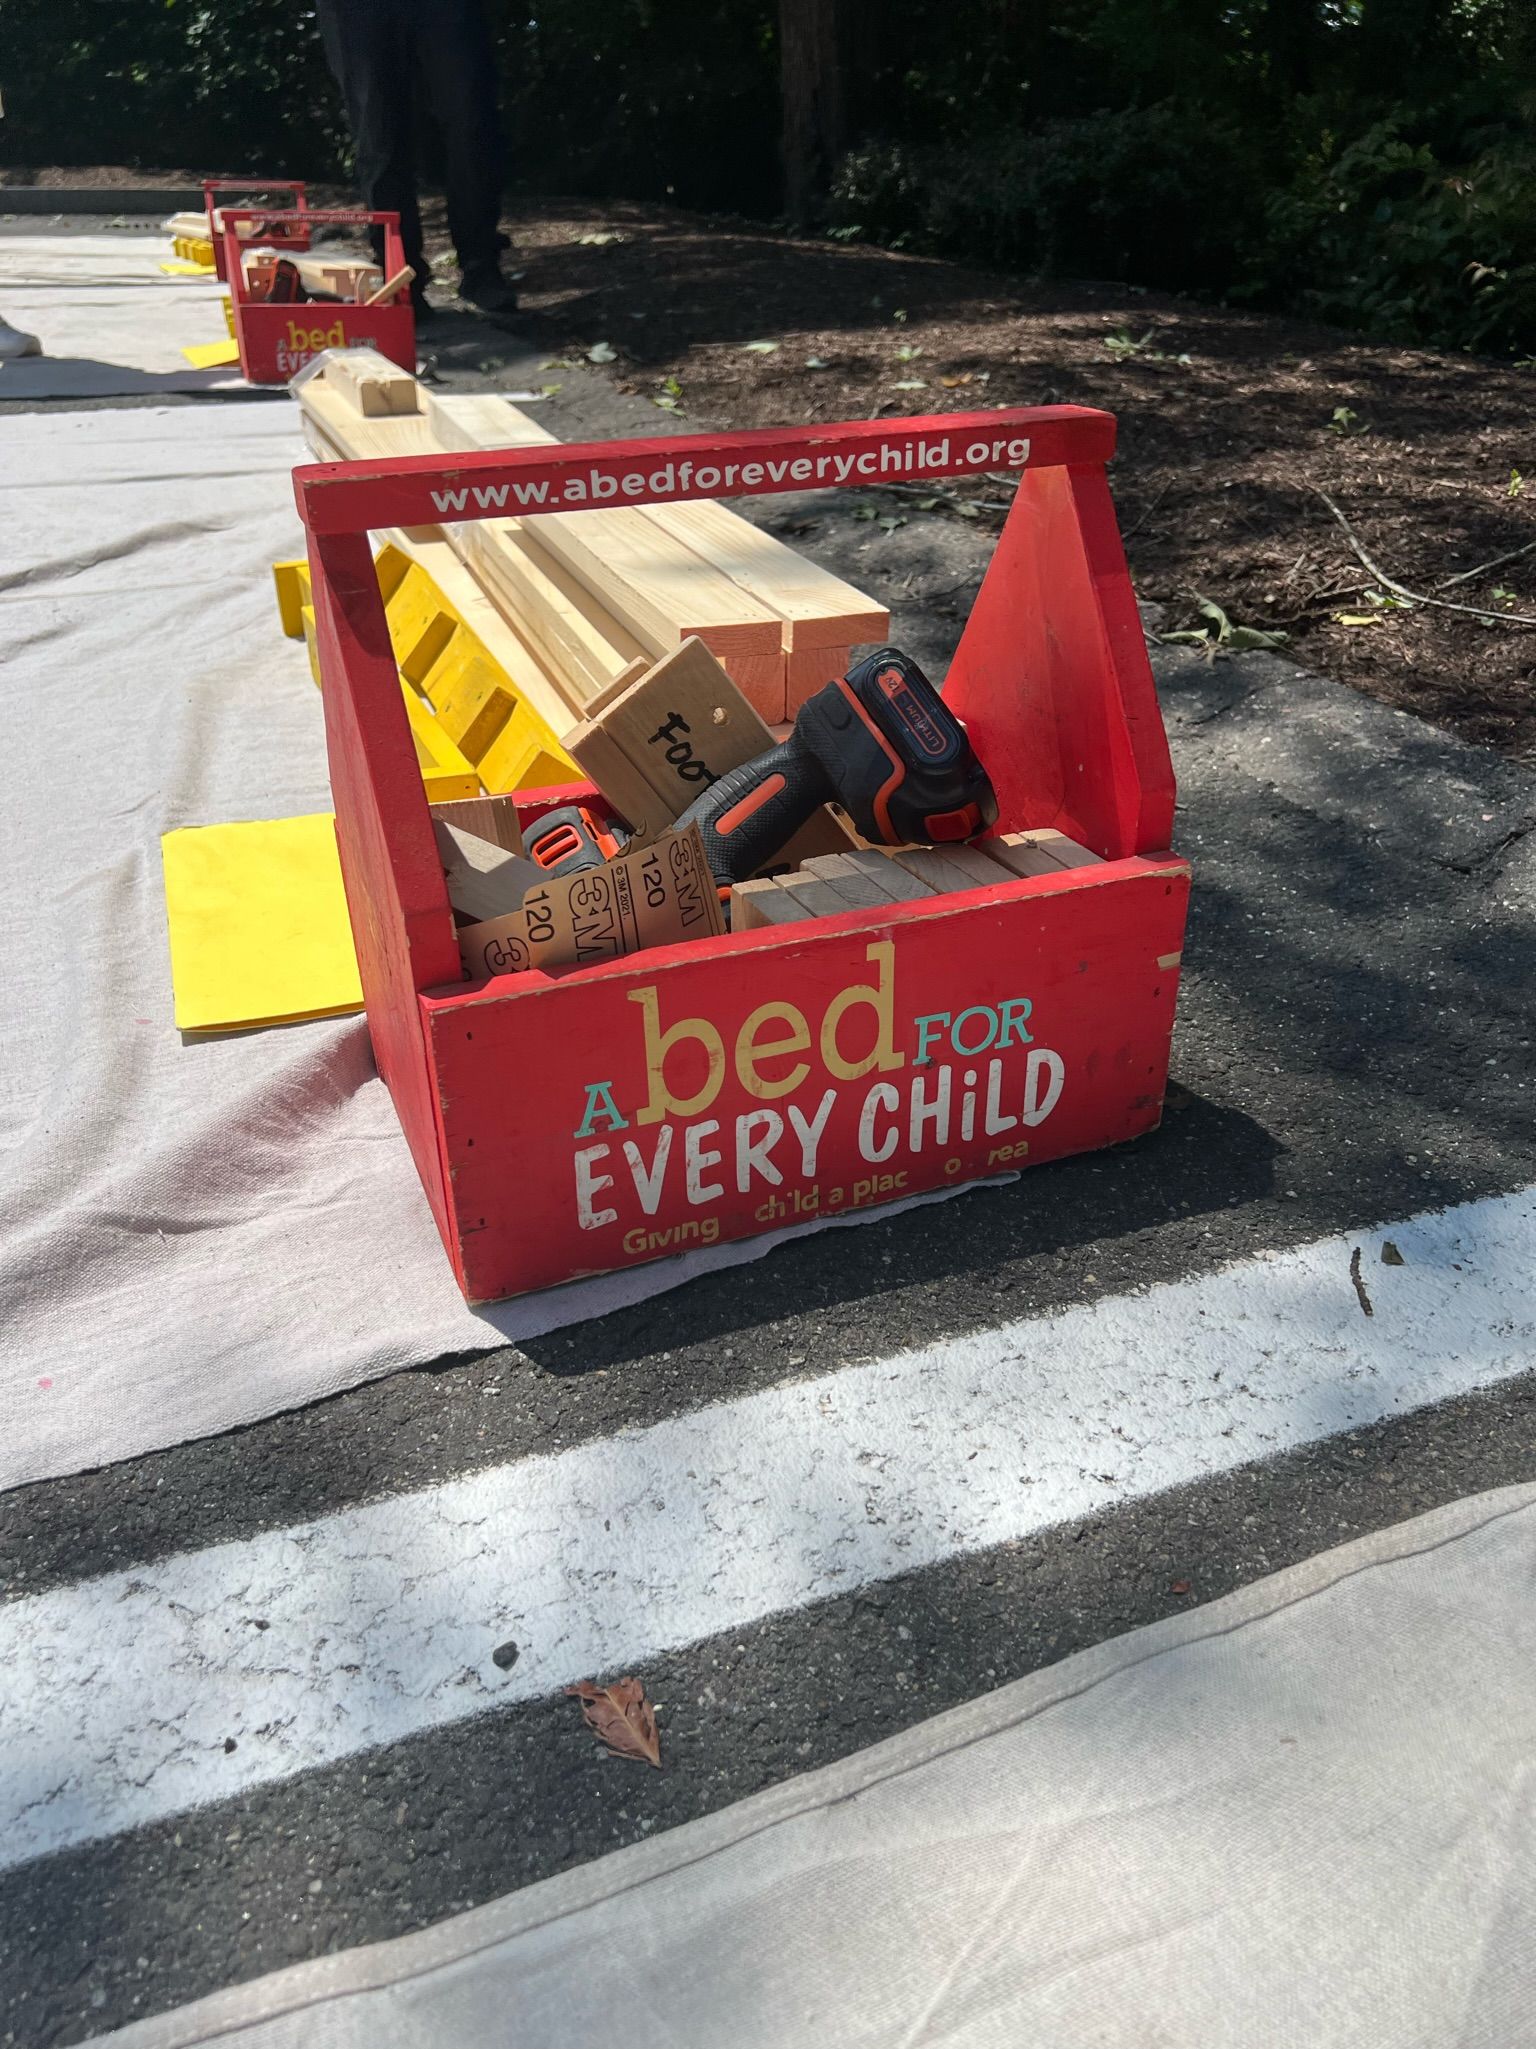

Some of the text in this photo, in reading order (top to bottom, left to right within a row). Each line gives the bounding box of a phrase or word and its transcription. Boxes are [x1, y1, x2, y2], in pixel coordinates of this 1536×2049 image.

[286, 320, 347, 351] bed
[430, 438, 1031, 512] www.abedforeverychild.org
[906, 704, 940, 748] LITHIUM
[641, 852, 666, 909] 120
[668, 838, 705, 928] 3M
[525, 889, 556, 943] 120
[568, 876, 619, 962] 3M
[484, 936, 530, 977] 3
[574, 940, 1034, 1139] A bed FOR
[574, 1088, 838, 1231] EVERY
[622, 1216, 720, 1254] Giving
[828, 1186, 844, 1205] a
